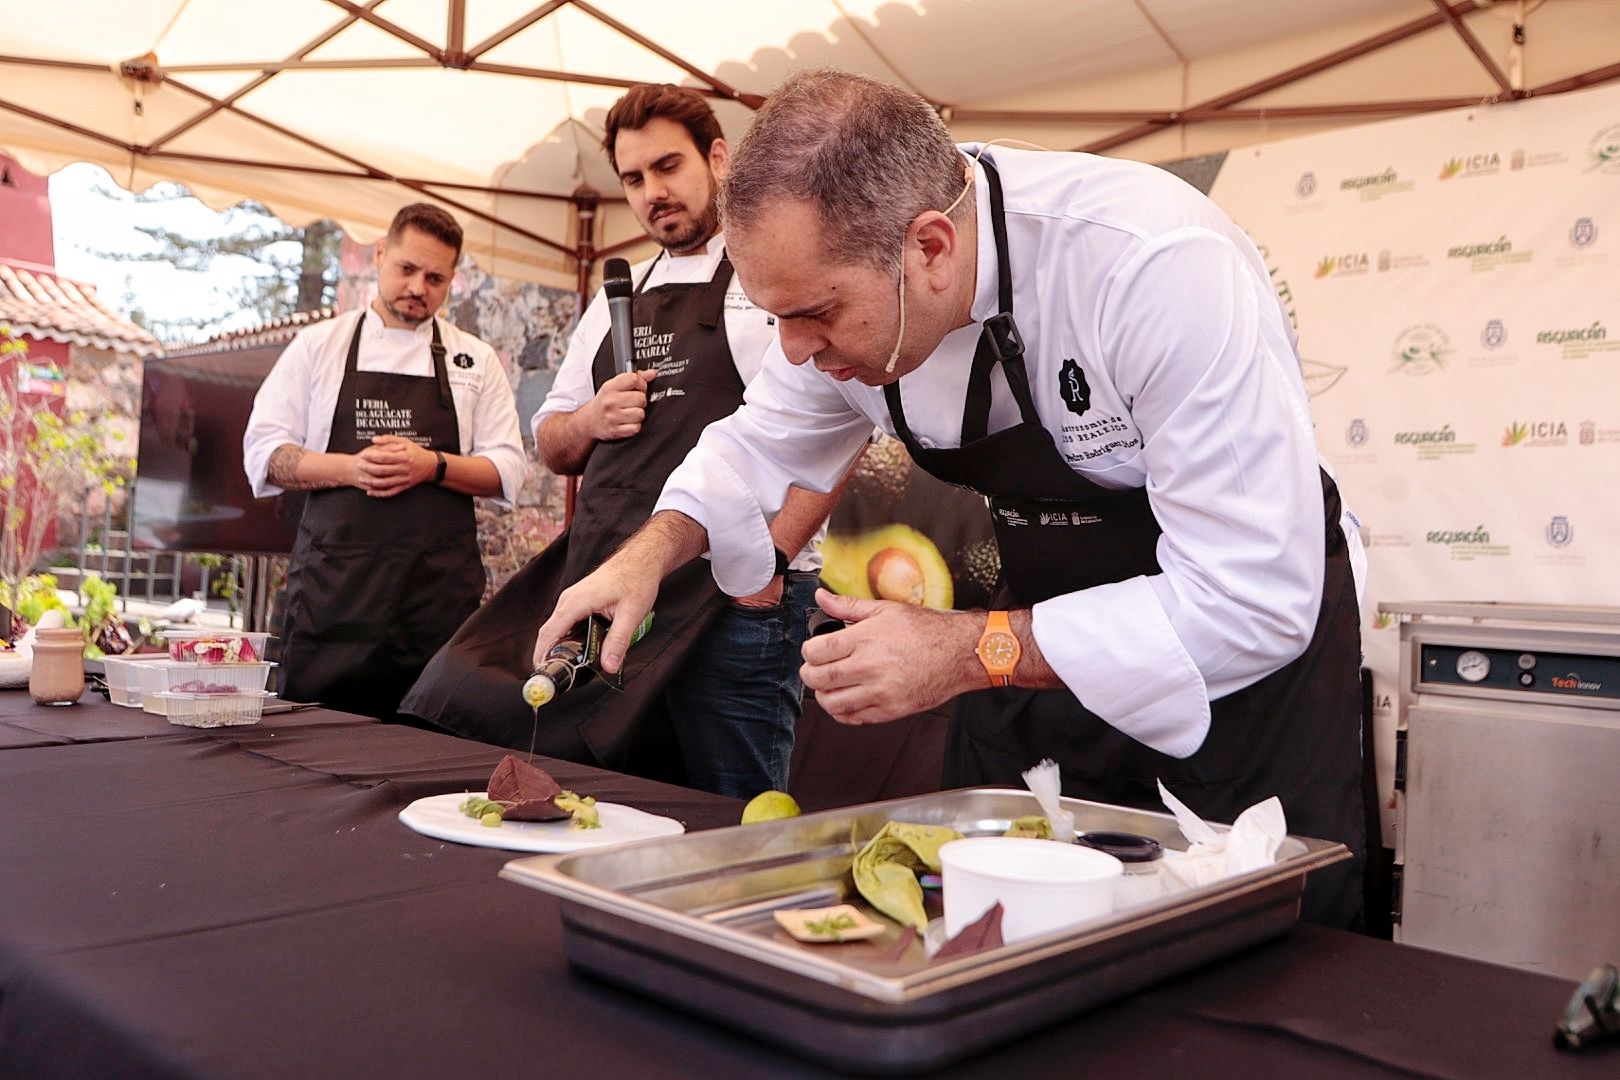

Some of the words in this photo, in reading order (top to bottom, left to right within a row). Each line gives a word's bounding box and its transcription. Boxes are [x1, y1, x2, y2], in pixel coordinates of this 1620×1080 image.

[1466, 153, 1500, 170] ICIA
[1338, 254, 1369, 269] ICIA
[633, 326, 652, 337] ERIA
[363, 399, 389, 409] FERIA
[369, 409, 412, 419] AGUACATE
[356, 418, 368, 428] DE
[369, 419, 411, 429] CANARIAS
[1077, 424, 1128, 442] REALEJOS
[1531, 422, 1568, 438] ICIA
[1050, 513, 1067, 521] ICIA
